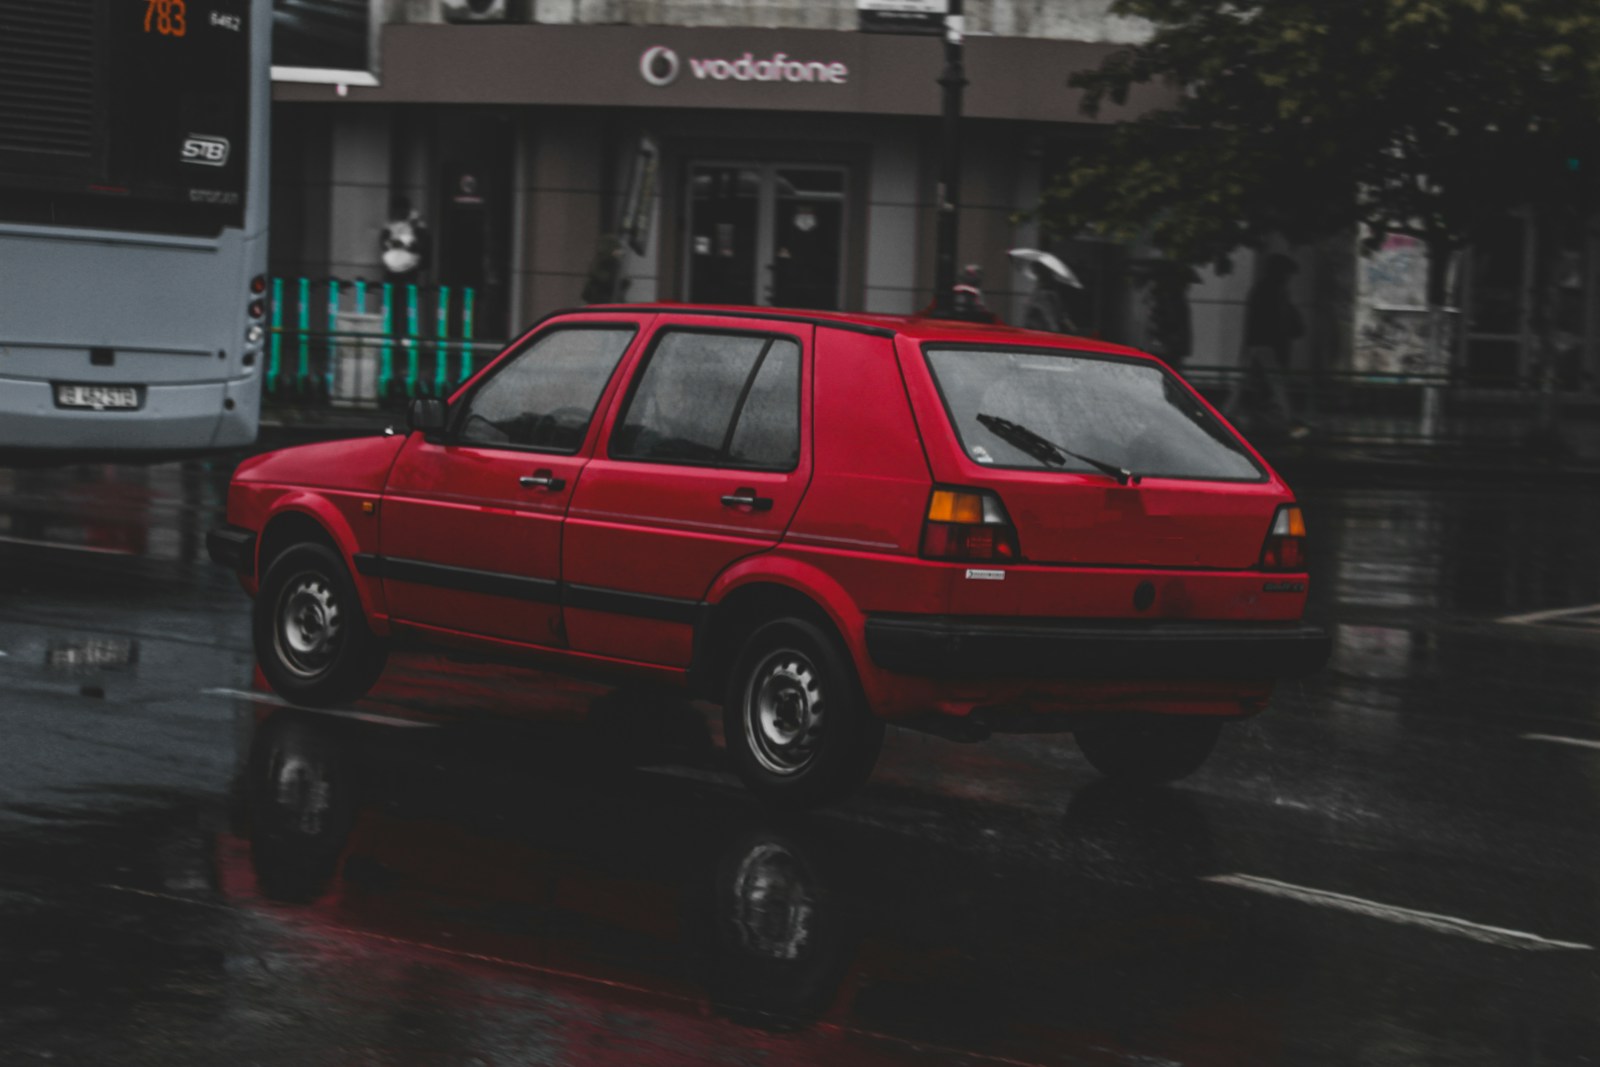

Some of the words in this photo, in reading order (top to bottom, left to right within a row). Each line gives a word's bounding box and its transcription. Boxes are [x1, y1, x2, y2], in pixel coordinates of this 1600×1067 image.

[143, 0, 186, 36] 783
[690, 53, 849, 84] vodafone
[181, 138, 226, 161] STB
